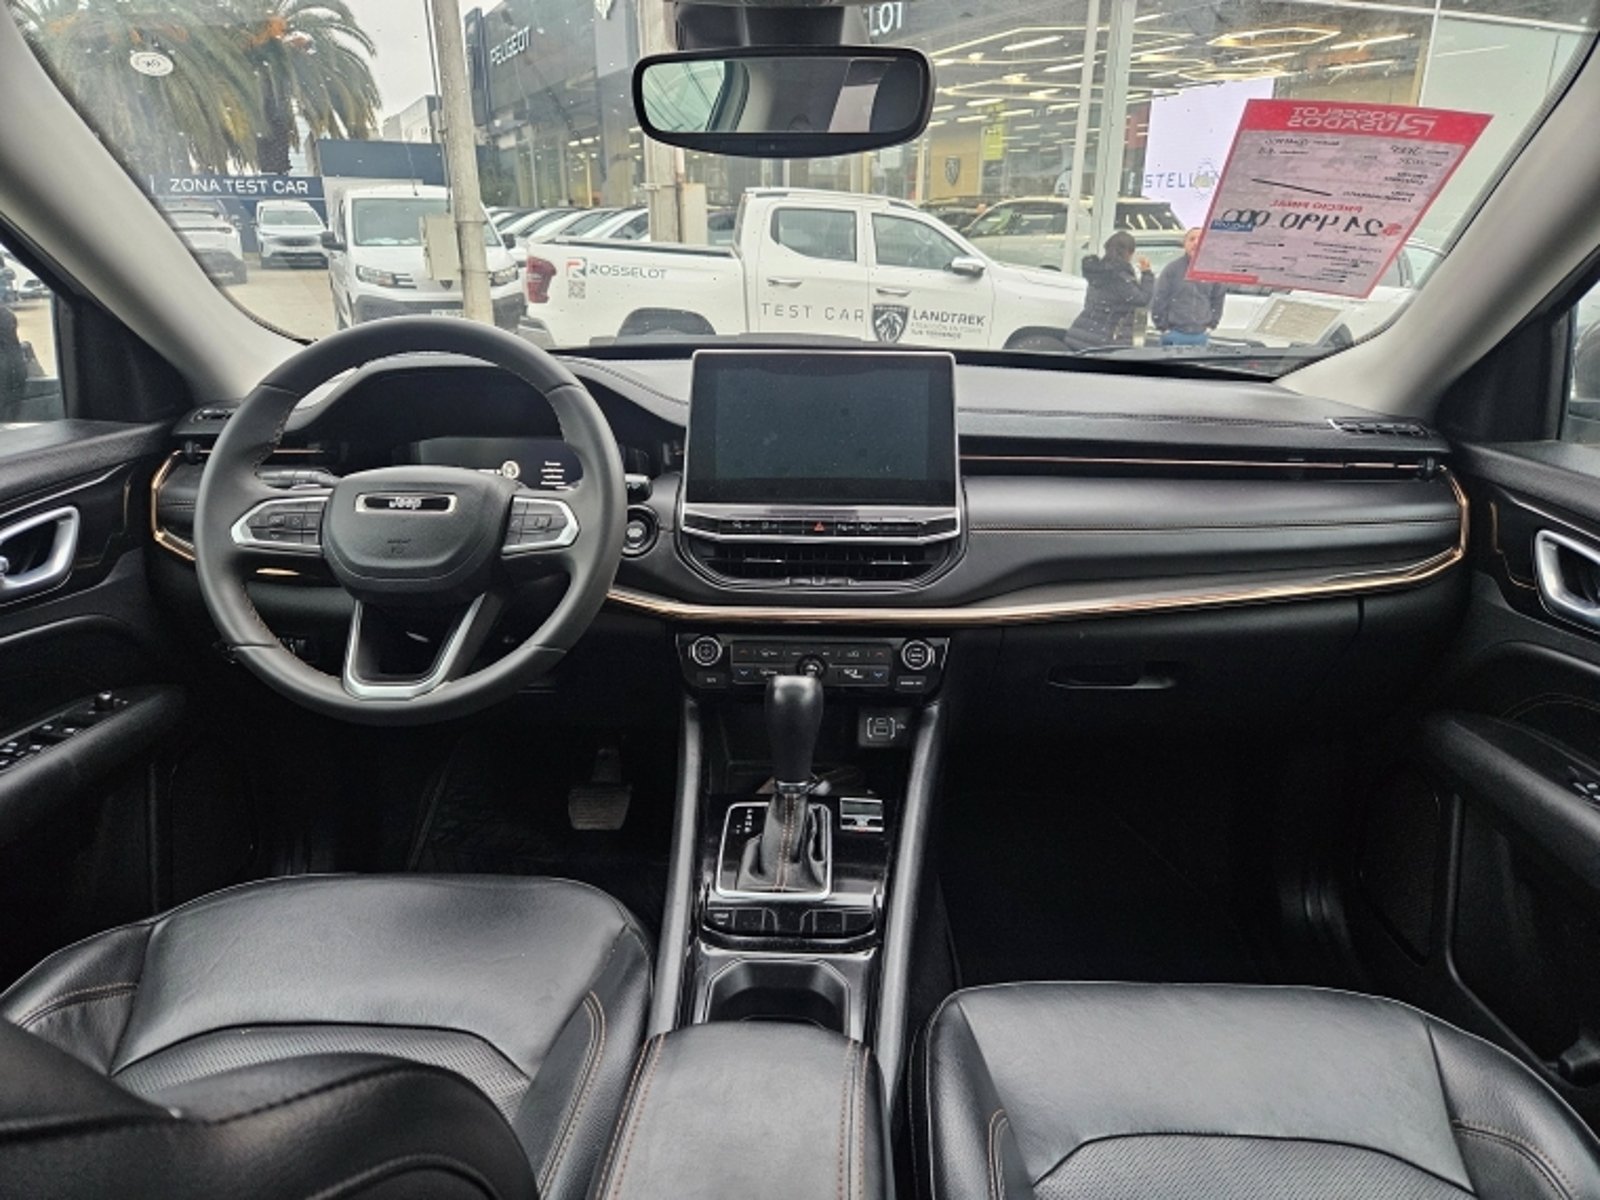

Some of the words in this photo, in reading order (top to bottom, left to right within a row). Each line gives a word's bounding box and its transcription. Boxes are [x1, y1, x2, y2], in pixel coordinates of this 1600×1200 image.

[489, 26, 529, 65] PEUGEOT
[170, 178, 221, 193] ZONA
[223, 180, 269, 194] TEST
[272, 180, 309, 195] CAR
[589, 262, 669, 279] ROSSELOT
[761, 302, 813, 318] TEST
[825, 307, 864, 322] CAR
[912, 309, 986, 327] LANDTREK
[388, 496, 422, 510] Jeep
